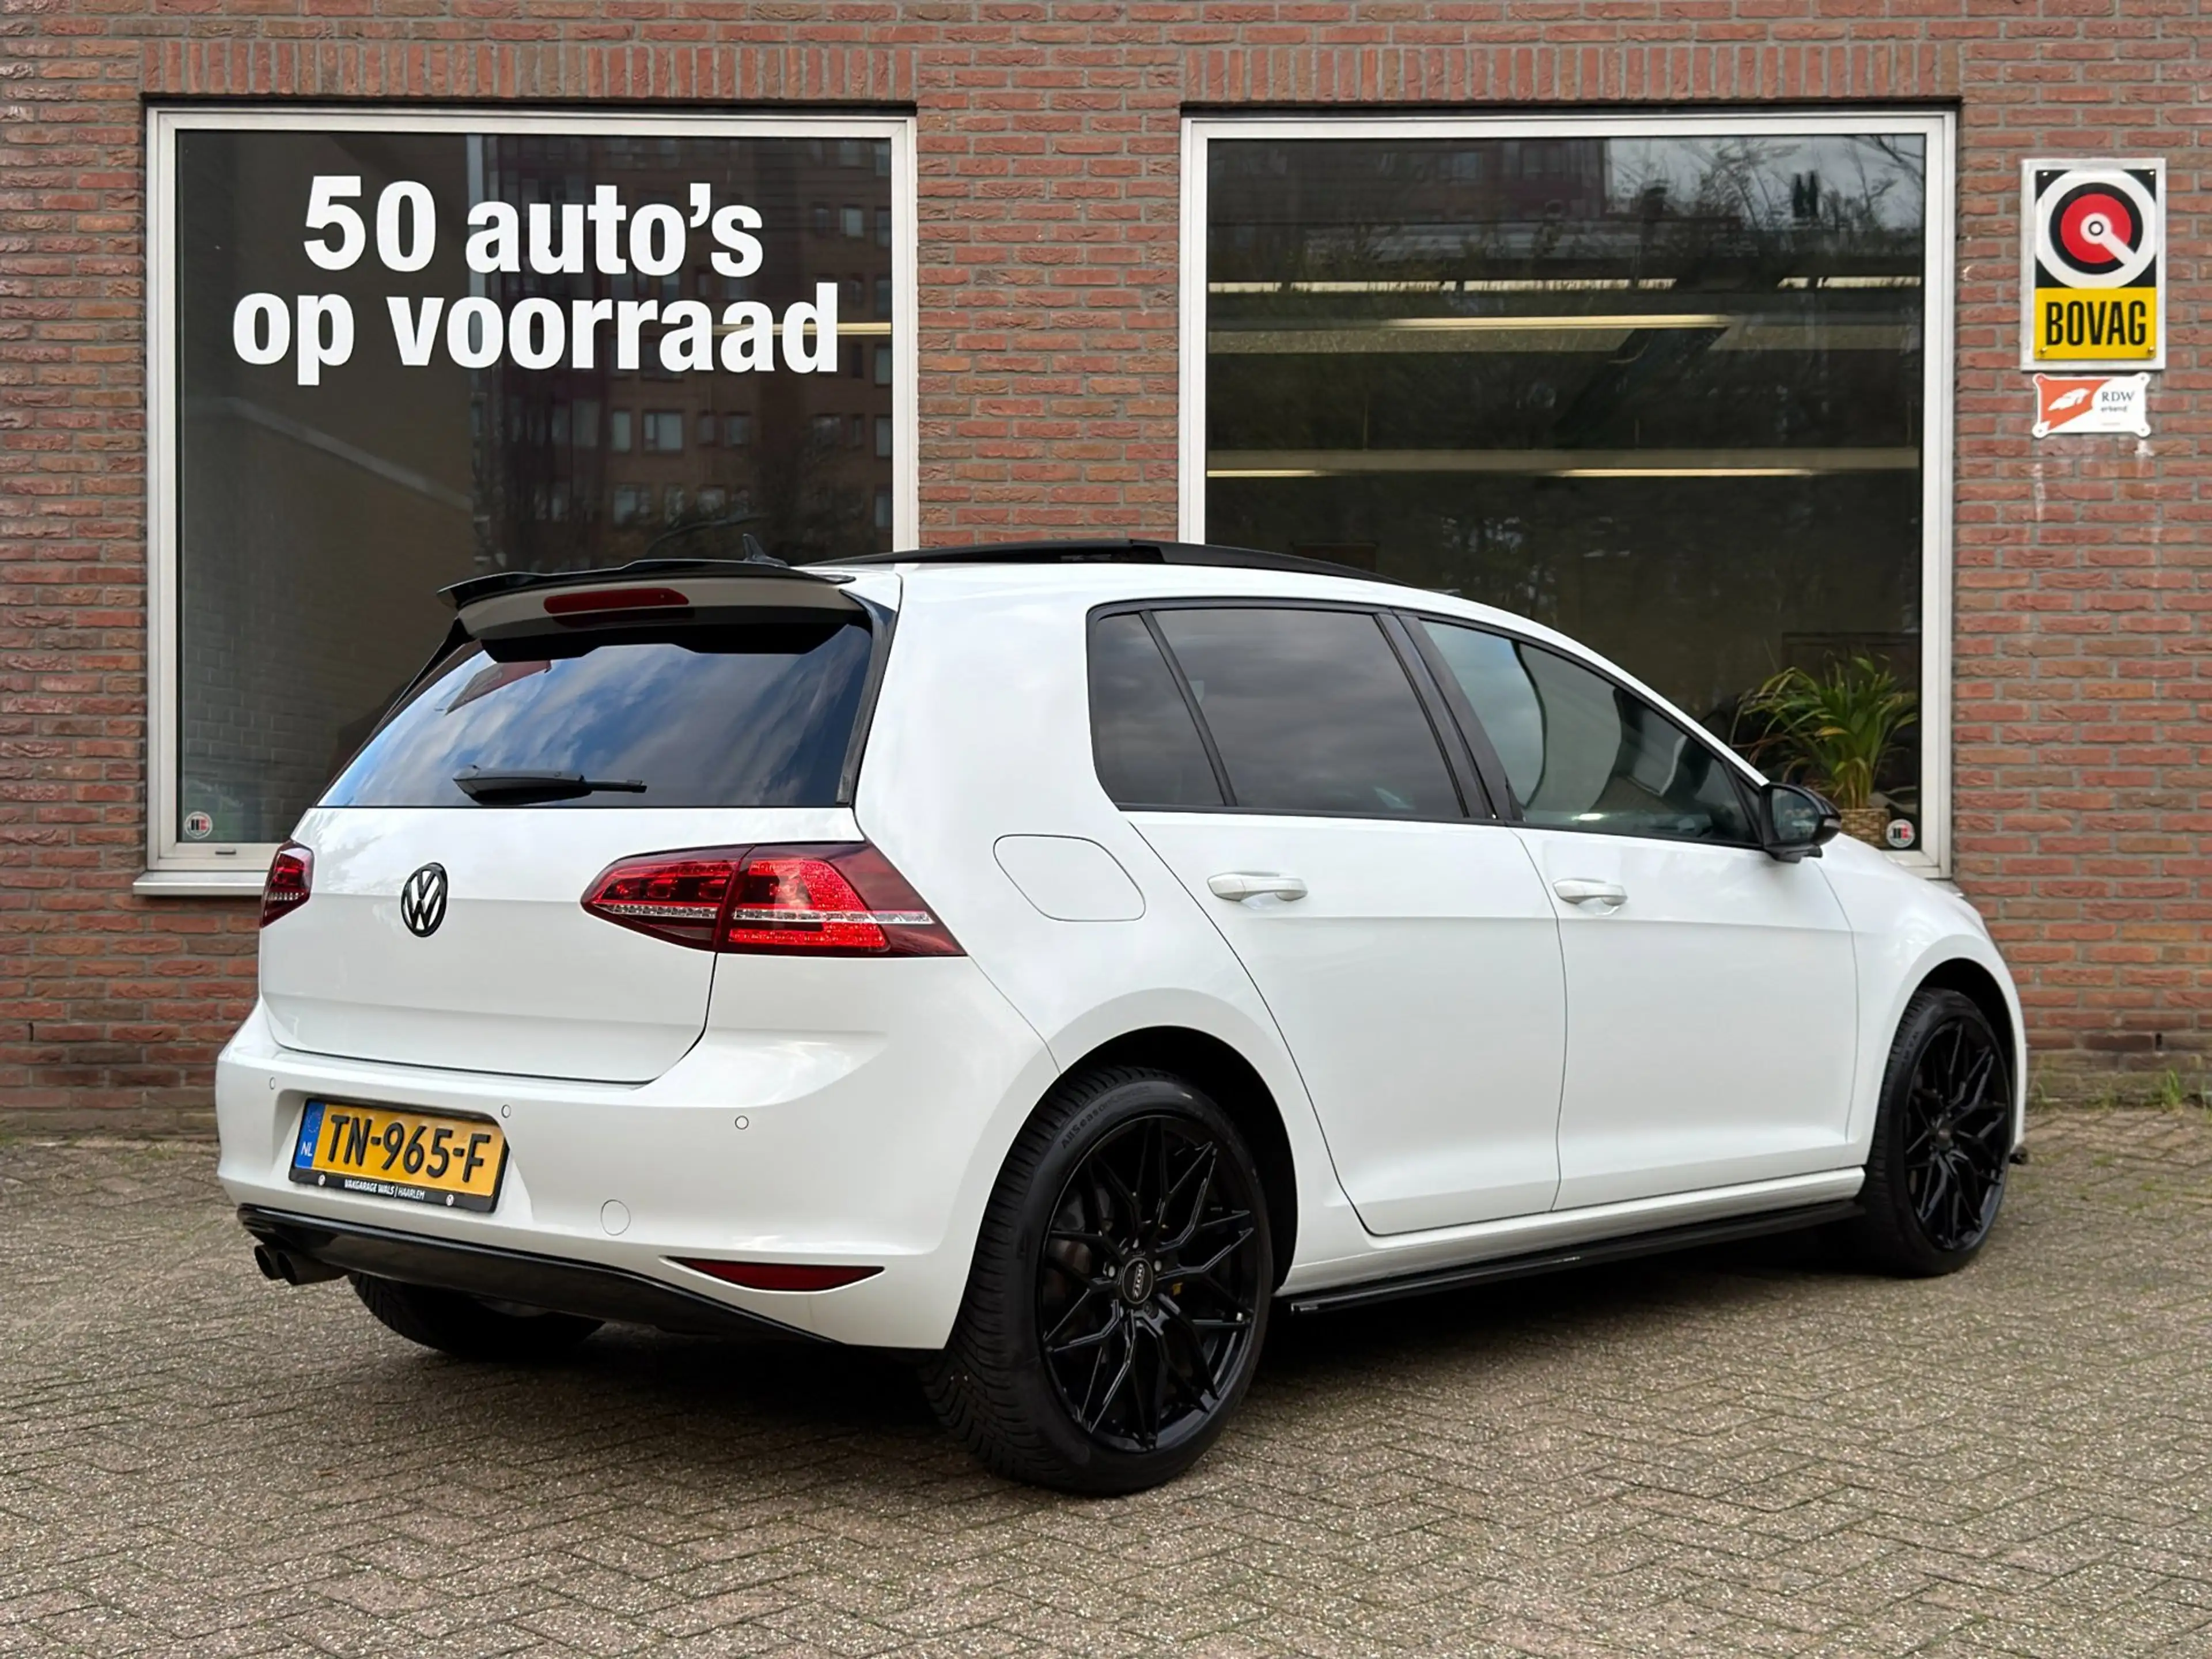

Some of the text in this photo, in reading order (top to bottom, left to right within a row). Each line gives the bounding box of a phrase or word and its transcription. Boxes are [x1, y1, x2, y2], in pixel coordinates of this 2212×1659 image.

[304, 175, 763, 277] 50 auto's
[233, 282, 838, 386] op voorraad
[2046, 300, 2147, 346] BOVAG
[2101, 390, 2135, 402] RDW
[300, 1141, 313, 1157] NL
[327, 1113, 491, 1183] TN-965-F
[344, 1179, 378, 1194] VAKGARAGE
[398, 1187, 425, 1200] HAARLEM
